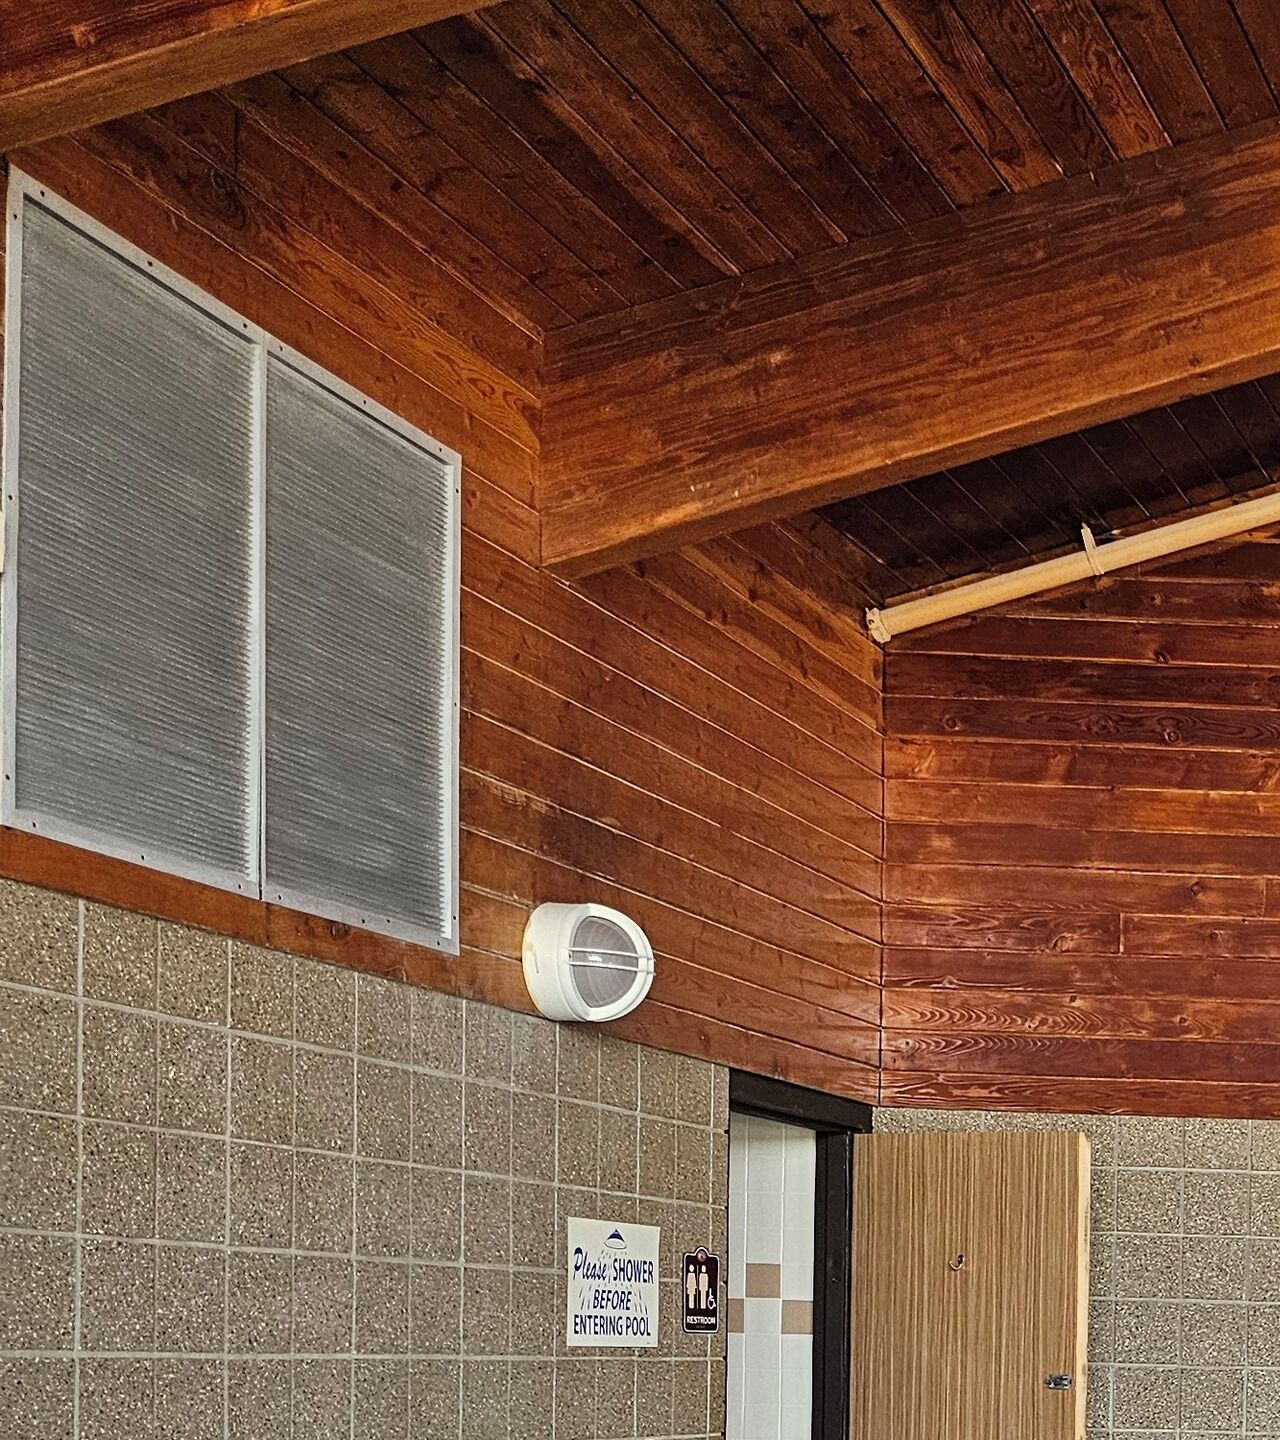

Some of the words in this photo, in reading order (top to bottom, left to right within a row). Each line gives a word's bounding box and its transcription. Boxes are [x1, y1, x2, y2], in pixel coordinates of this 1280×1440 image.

[573, 1247, 607, 1281] Please
[613, 1258, 654, 1284] SHOWER
[593, 1289, 632, 1310] BEFORE
[574, 1315, 624, 1336] ENTERING
[626, 1316, 651, 1336] POOL
[687, 1317, 716, 1325] RESTROOM
